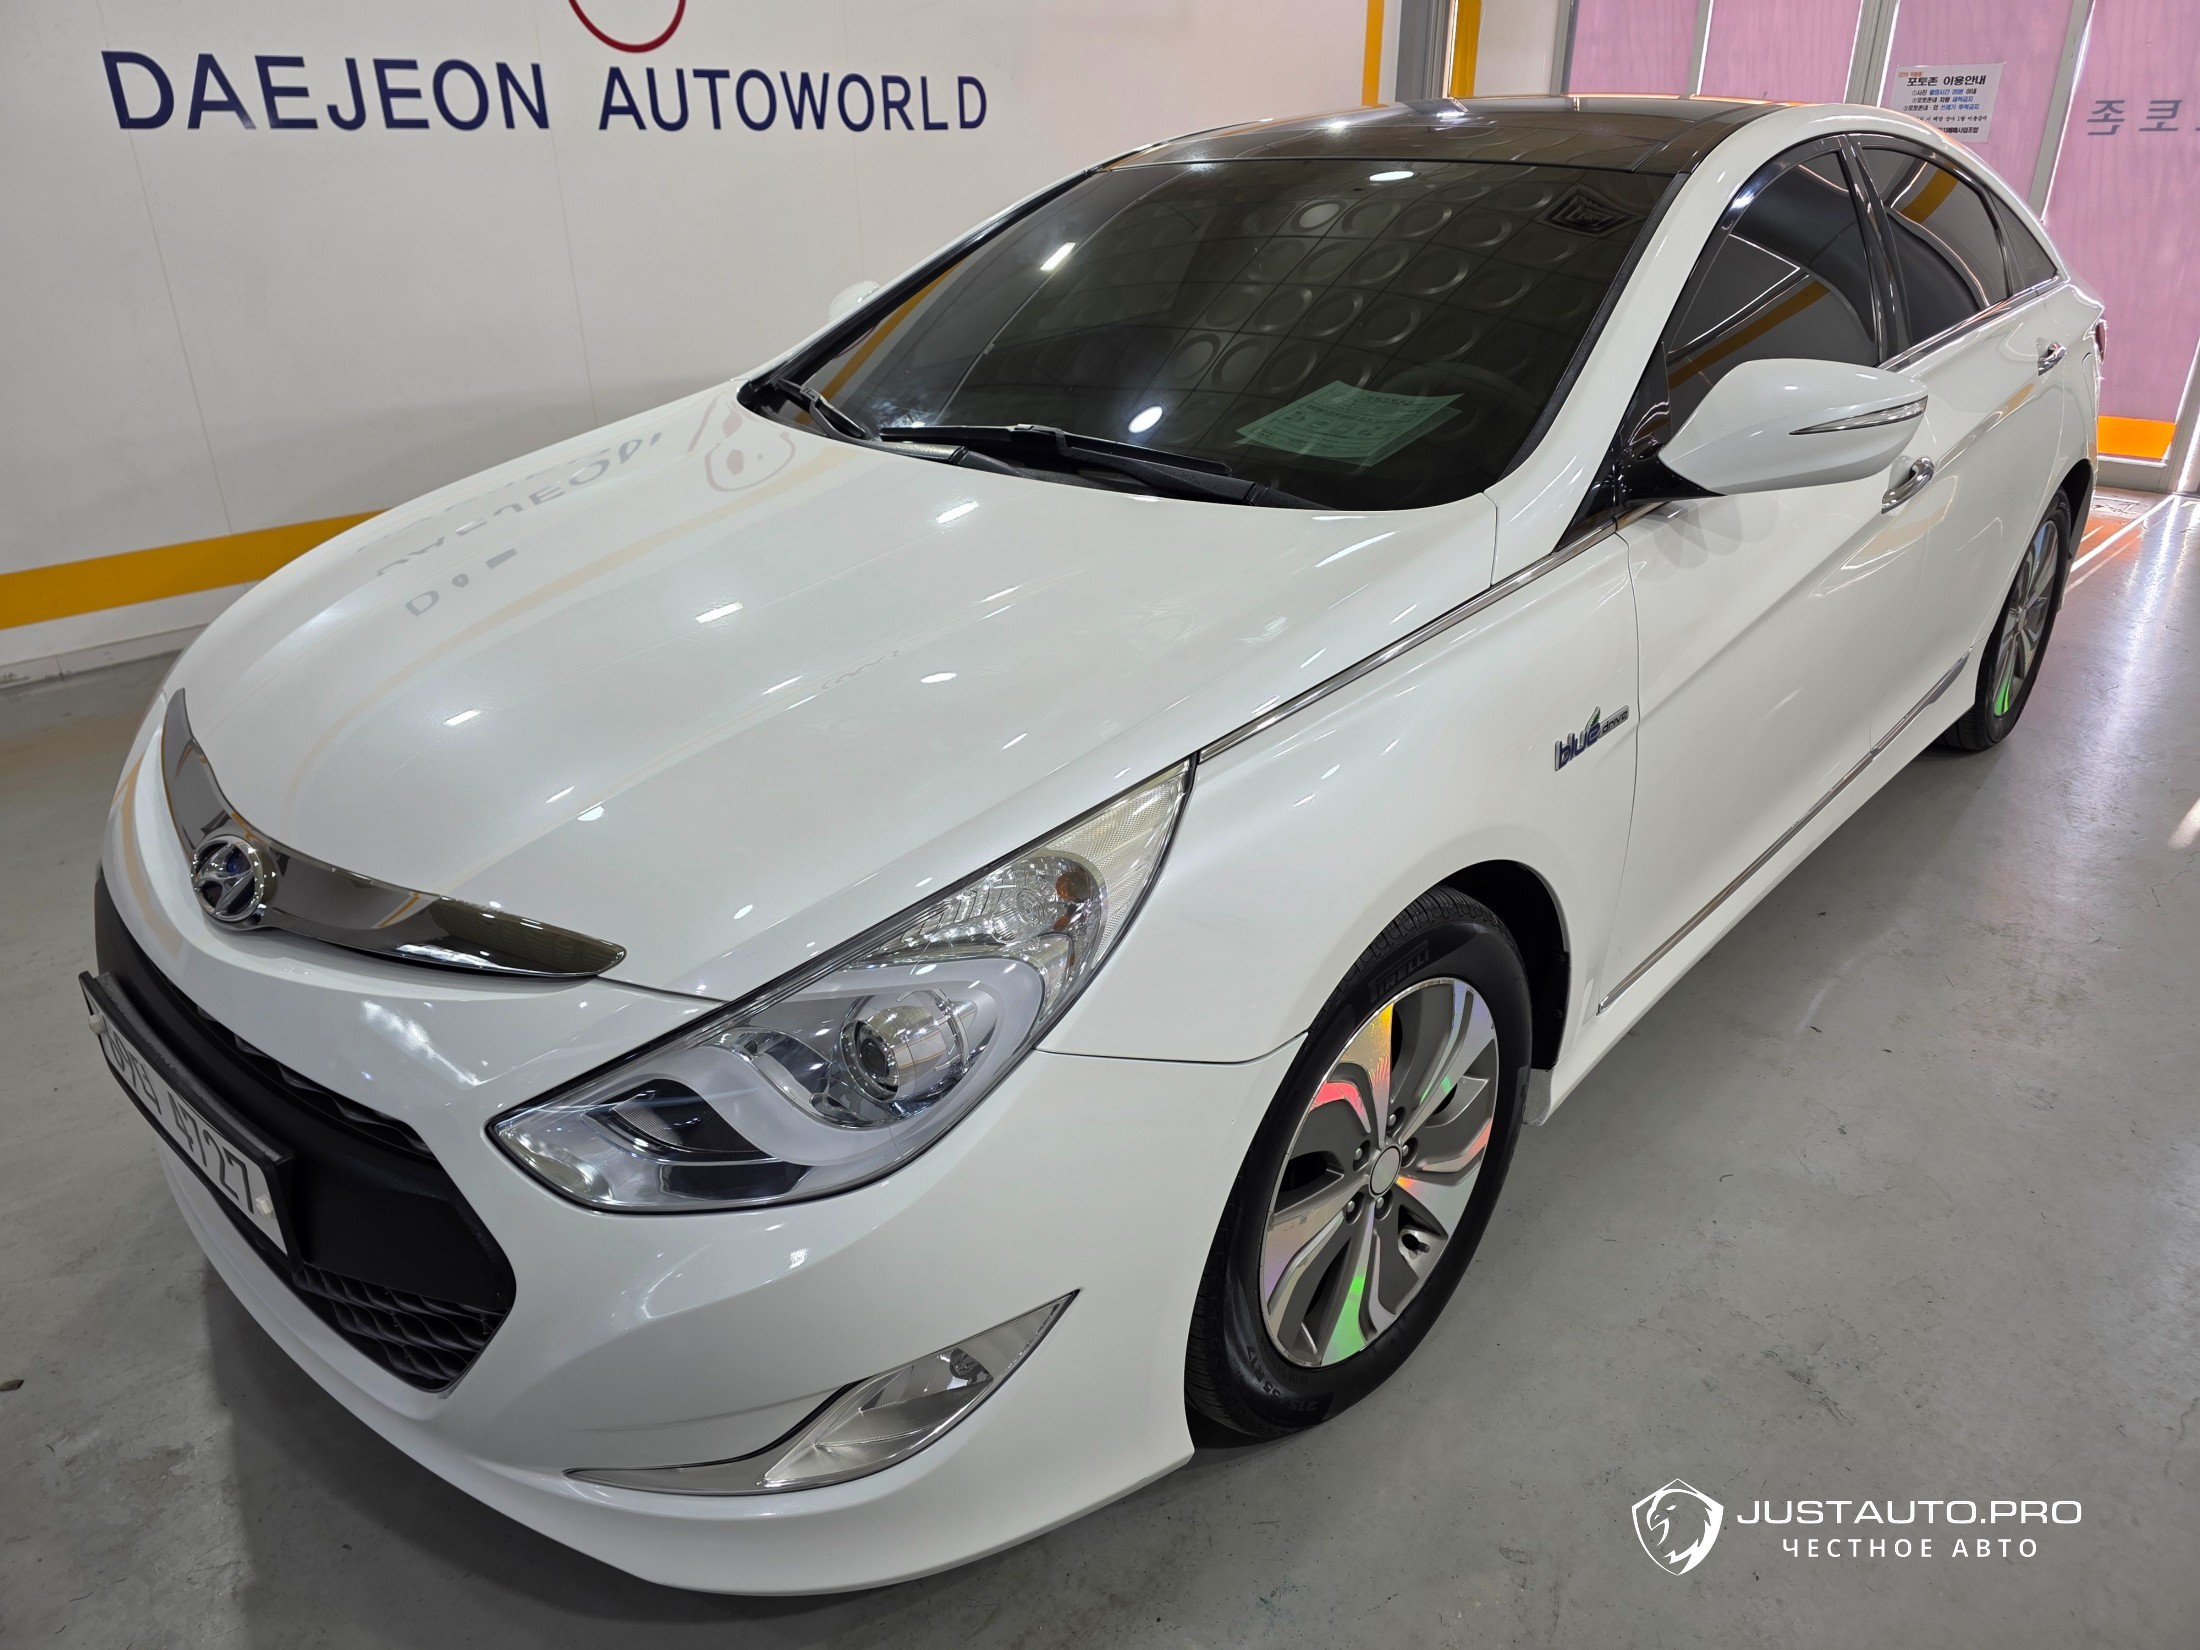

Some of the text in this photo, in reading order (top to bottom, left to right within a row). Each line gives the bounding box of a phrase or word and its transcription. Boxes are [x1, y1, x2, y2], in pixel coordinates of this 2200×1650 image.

[100, 50, 989, 132] DAEJEON AUTOWORLD
[1906, 75, 1986, 86] 포토존 이용안내
[1555, 709, 1629, 771] blue drive
[1368, 940, 1430, 1004] PIRELLI
[167, 1090, 254, 1214] 4727
